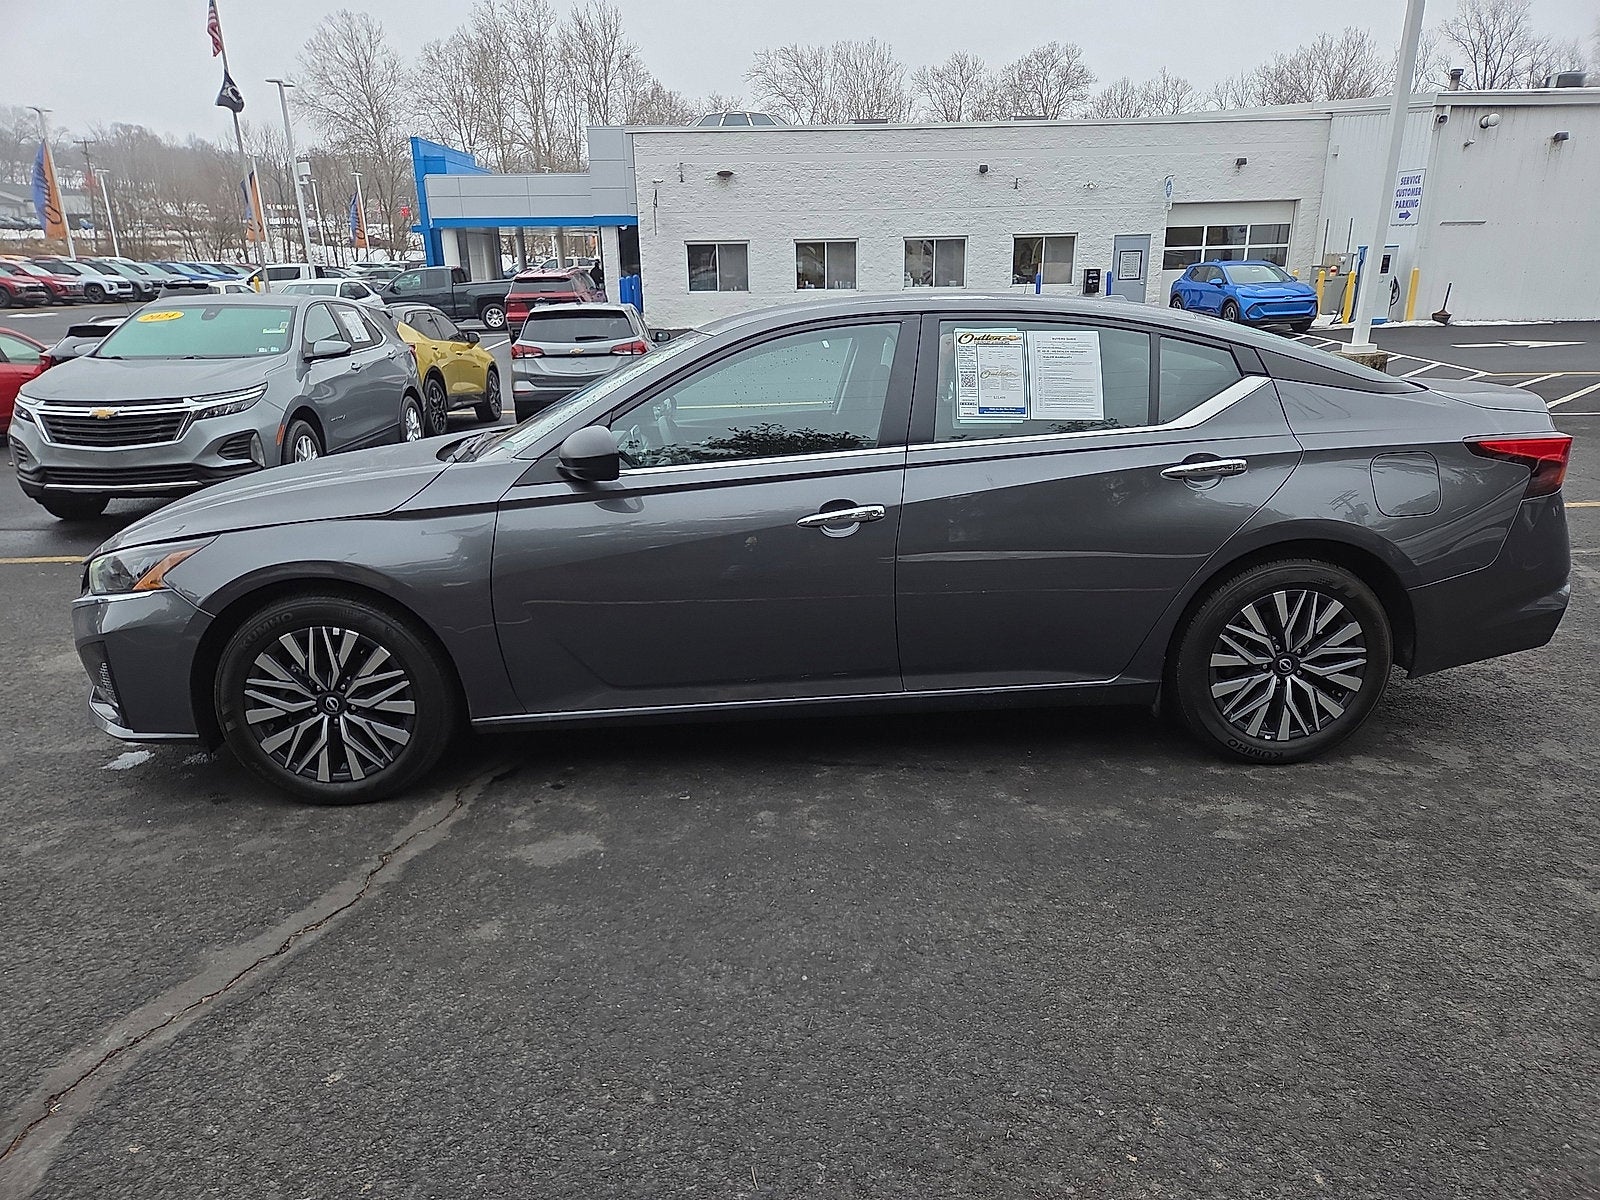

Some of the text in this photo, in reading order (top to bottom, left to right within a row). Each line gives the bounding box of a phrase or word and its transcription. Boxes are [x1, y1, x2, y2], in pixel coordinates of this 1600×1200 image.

[1400, 174, 1421, 185] SERVICE
[1395, 187, 1421, 197] CUSTOMER
[1394, 199, 1419, 209] PARKING
[239, 612, 294, 650] KUMHO
[1227, 739, 1284, 760] KUMHO
